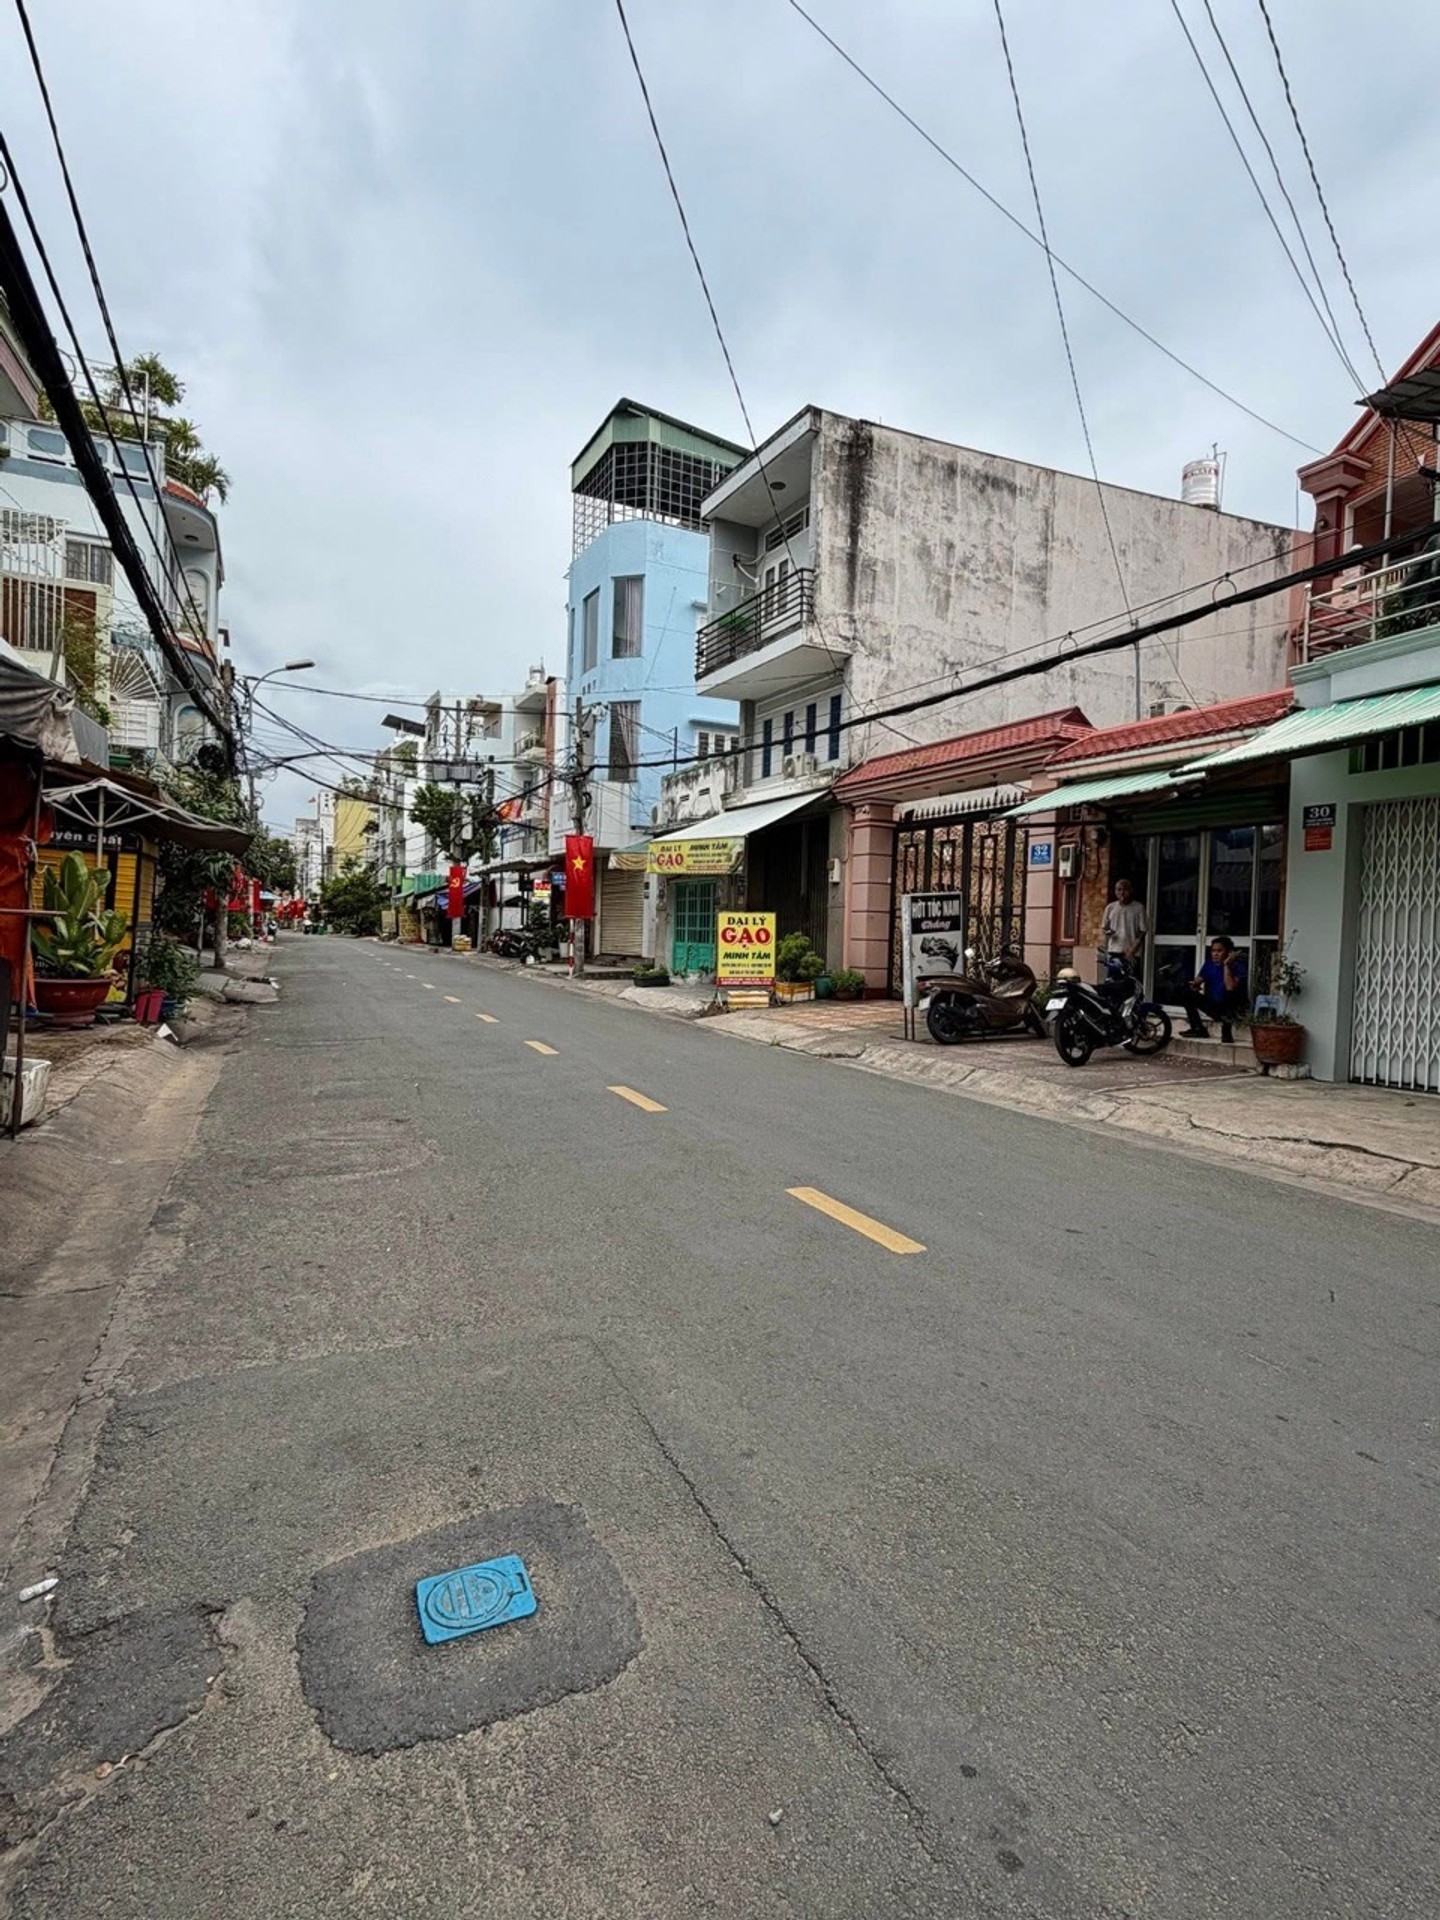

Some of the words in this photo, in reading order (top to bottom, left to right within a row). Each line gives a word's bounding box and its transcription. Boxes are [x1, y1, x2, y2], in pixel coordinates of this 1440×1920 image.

[1309, 806, 1330, 818] 30
[1034, 845, 1048, 855] 32
[721, 927, 772, 949] GẠO
[723, 952, 749, 960] MINH
